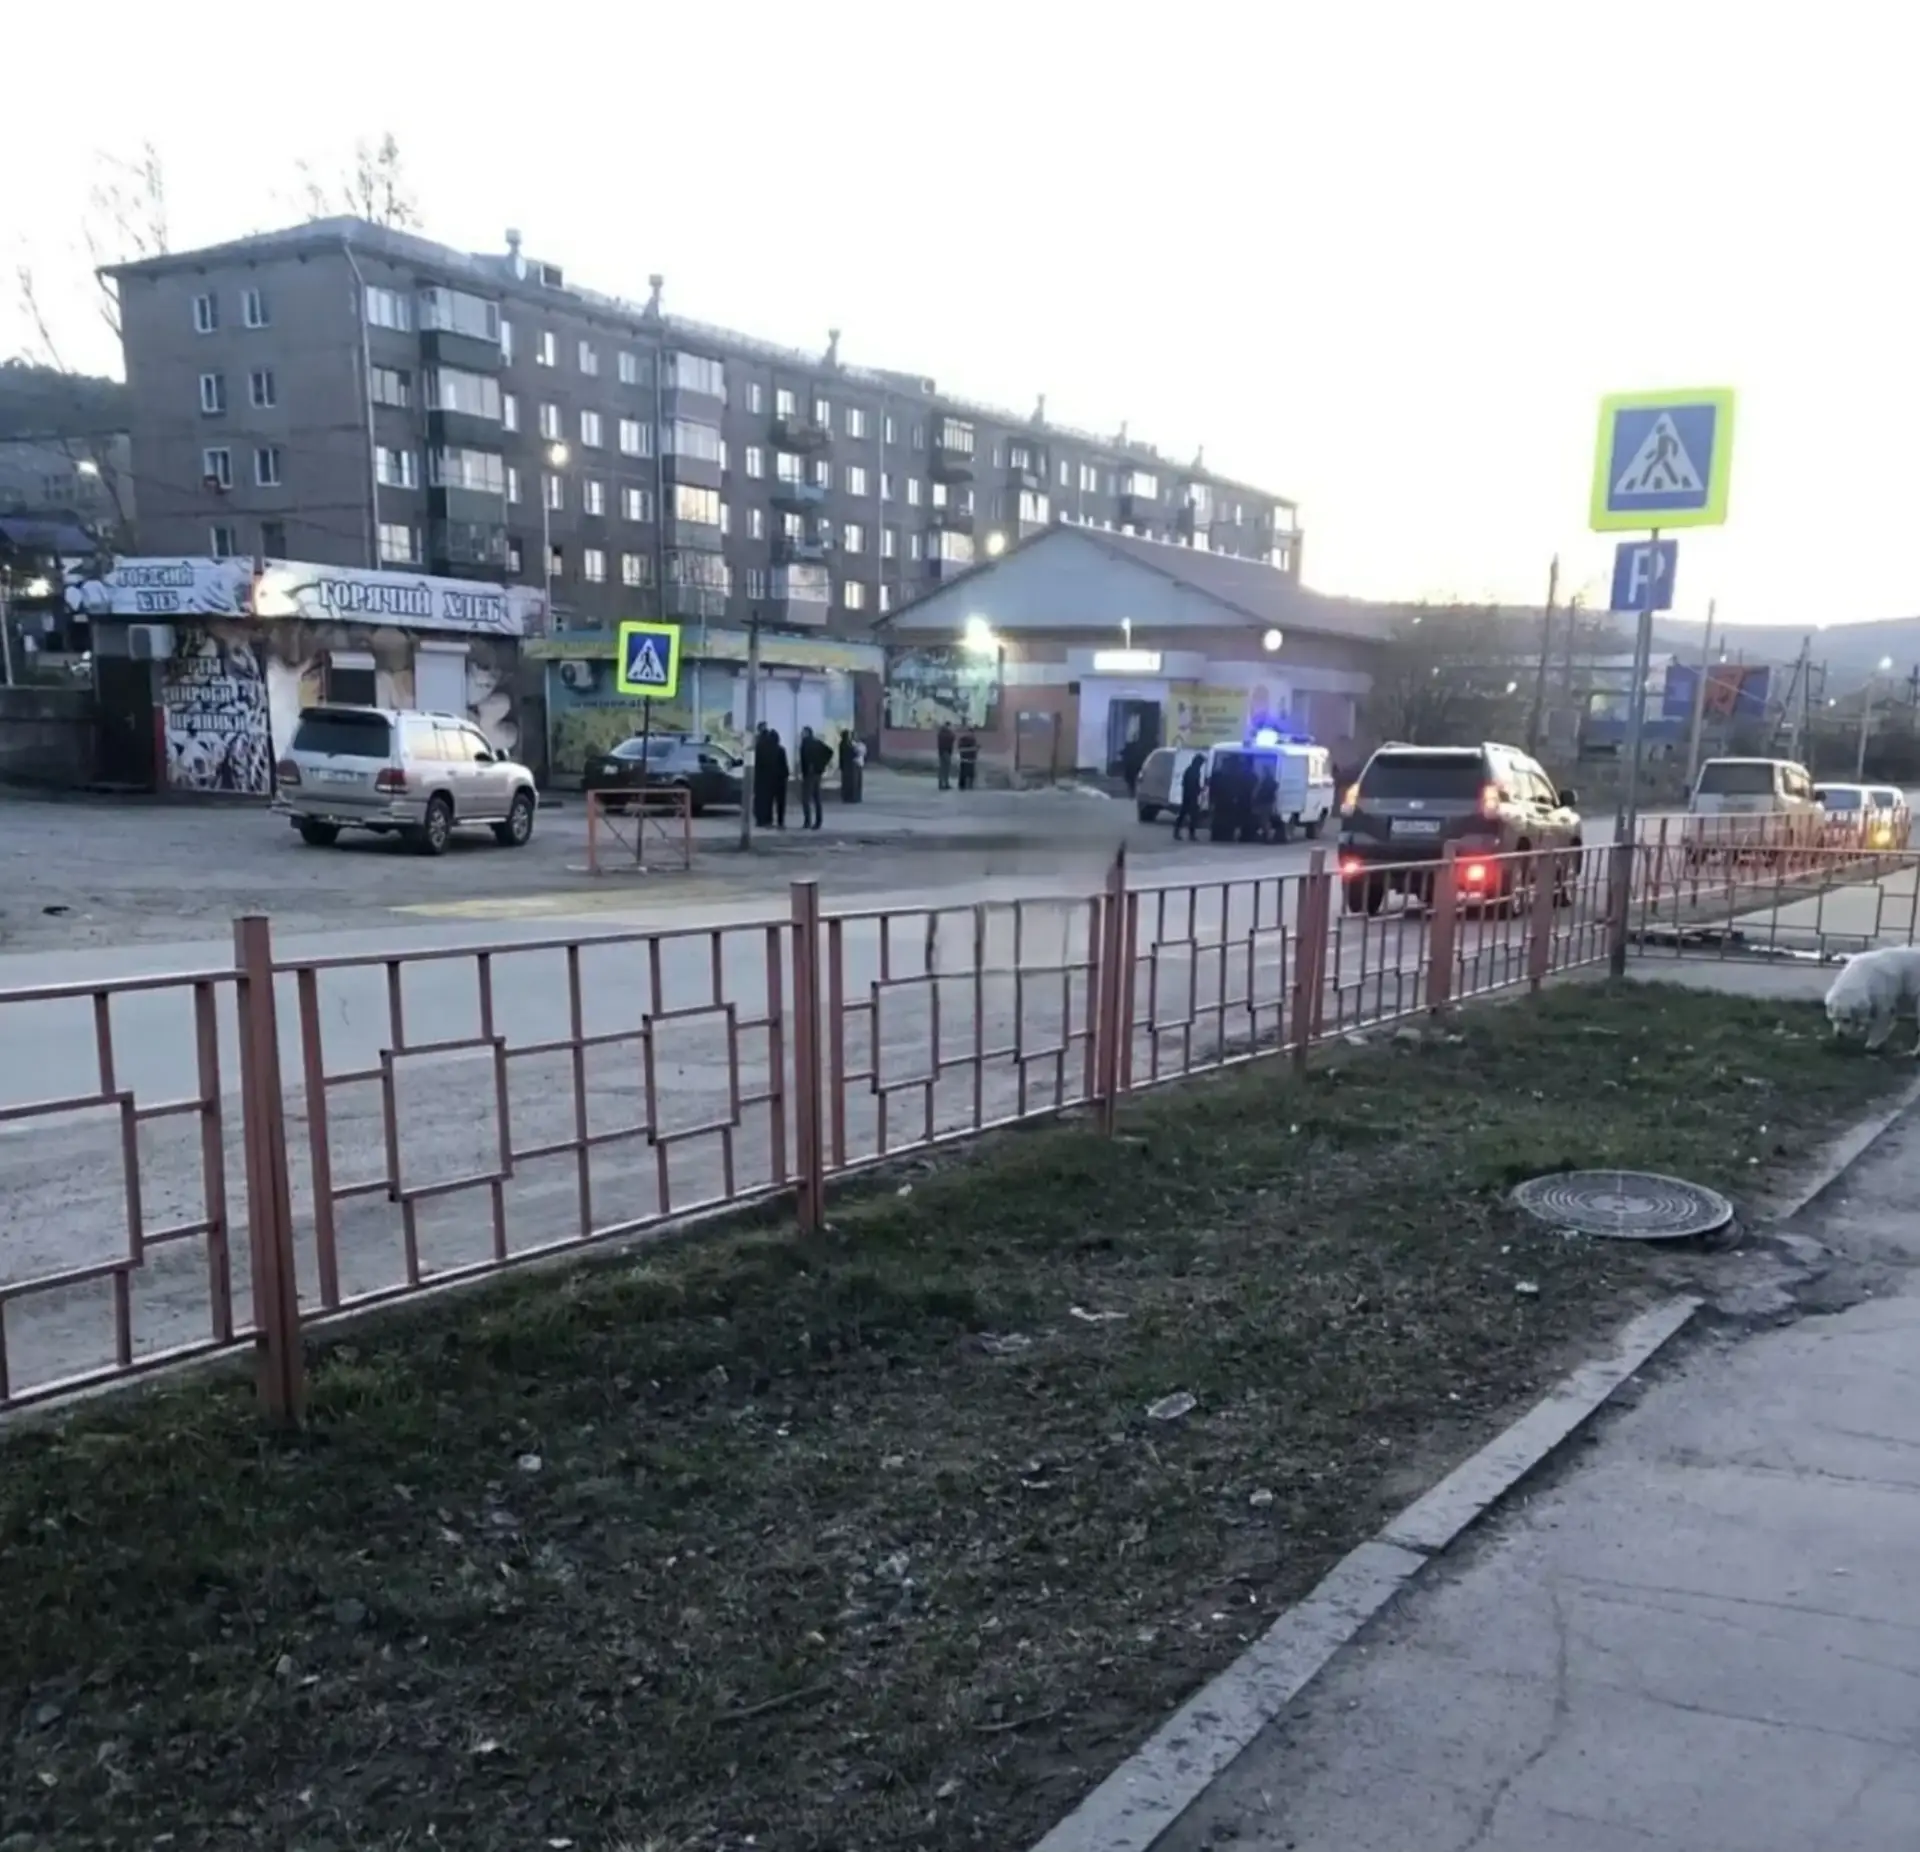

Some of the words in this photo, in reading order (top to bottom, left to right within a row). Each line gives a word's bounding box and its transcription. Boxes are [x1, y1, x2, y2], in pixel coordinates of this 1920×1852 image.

[116, 561, 195, 587] ГОРЯЧИЙ
[136, 590, 180, 612] ХЛЕБ
[318, 579, 433, 617] ГОРЯЧИЙ
[442, 591, 502, 622] ХЛЕБ
